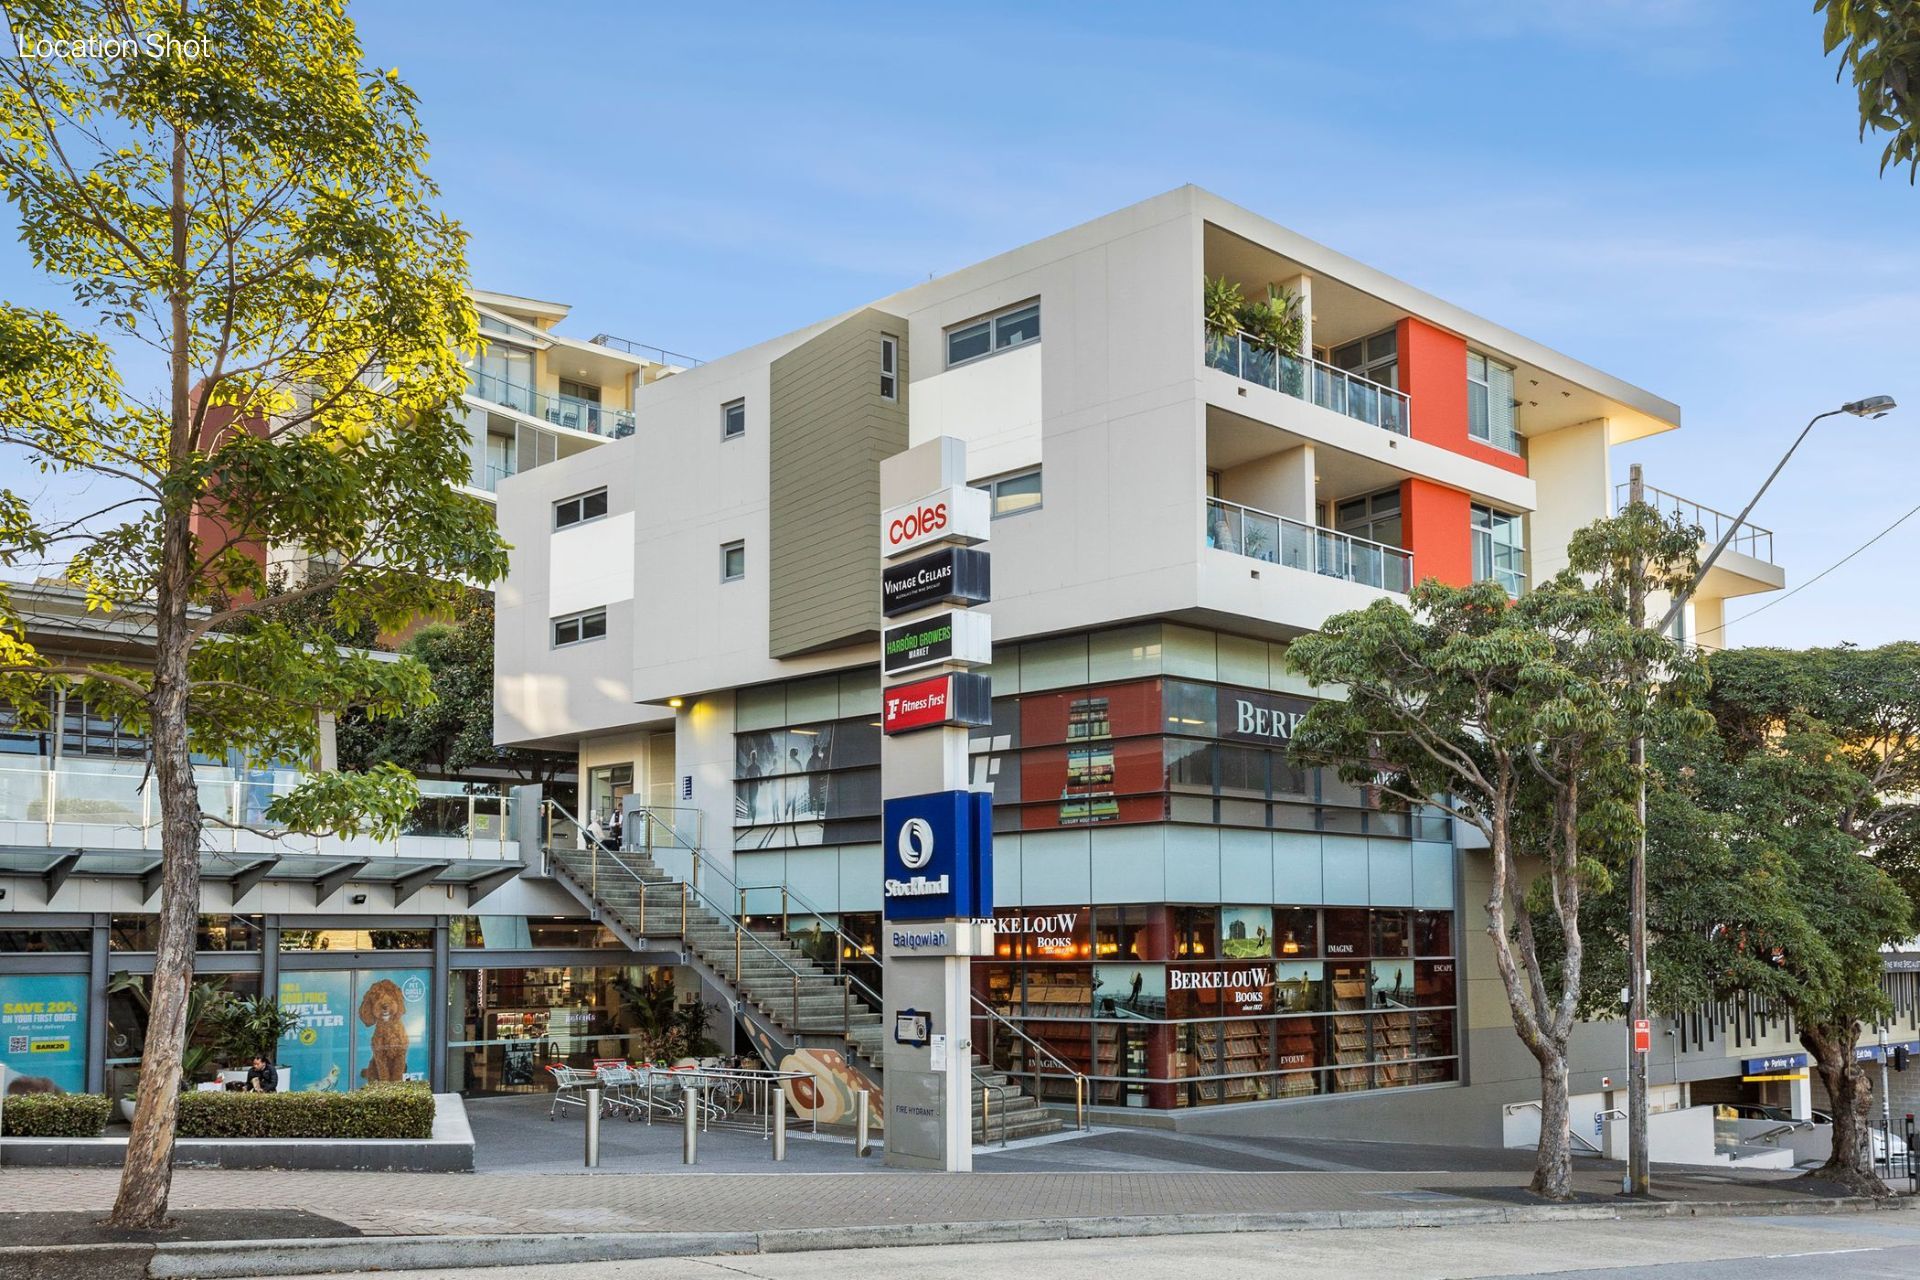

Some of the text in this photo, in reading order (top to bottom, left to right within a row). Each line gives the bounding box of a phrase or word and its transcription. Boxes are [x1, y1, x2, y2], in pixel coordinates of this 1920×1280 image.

[889, 503, 947, 545] coles
[885, 565, 952, 595] VINTAGE CELLARS
[919, 626, 952, 646] GROWERS
[908, 646, 930, 659] MARKET
[901, 698, 927, 714] Fitness
[928, 693, 945, 709] First
[885, 874, 949, 897] Stockland
[893, 931, 946, 950] Balgowlah
[1037, 937, 1072, 948] BOOKS
[1327, 944, 1354, 953] IMAGINE
[1433, 964, 1453, 972] ESCAPE
[1169, 967, 1268, 990] BERKELOUW
[1235, 991, 1263, 1003] BOOKS
[3, 1001, 78, 1014] SAVE 20%
[2, 1013, 77, 1024] ON YOUR FIRST ORDER
[1280, 1054, 1305, 1065] EVOLVE
[1771, 1059, 1788, 1068] Parking
[402, 1072, 424, 1082] PET
[896, 1105, 934, 1116] FIRE HYDRANT
